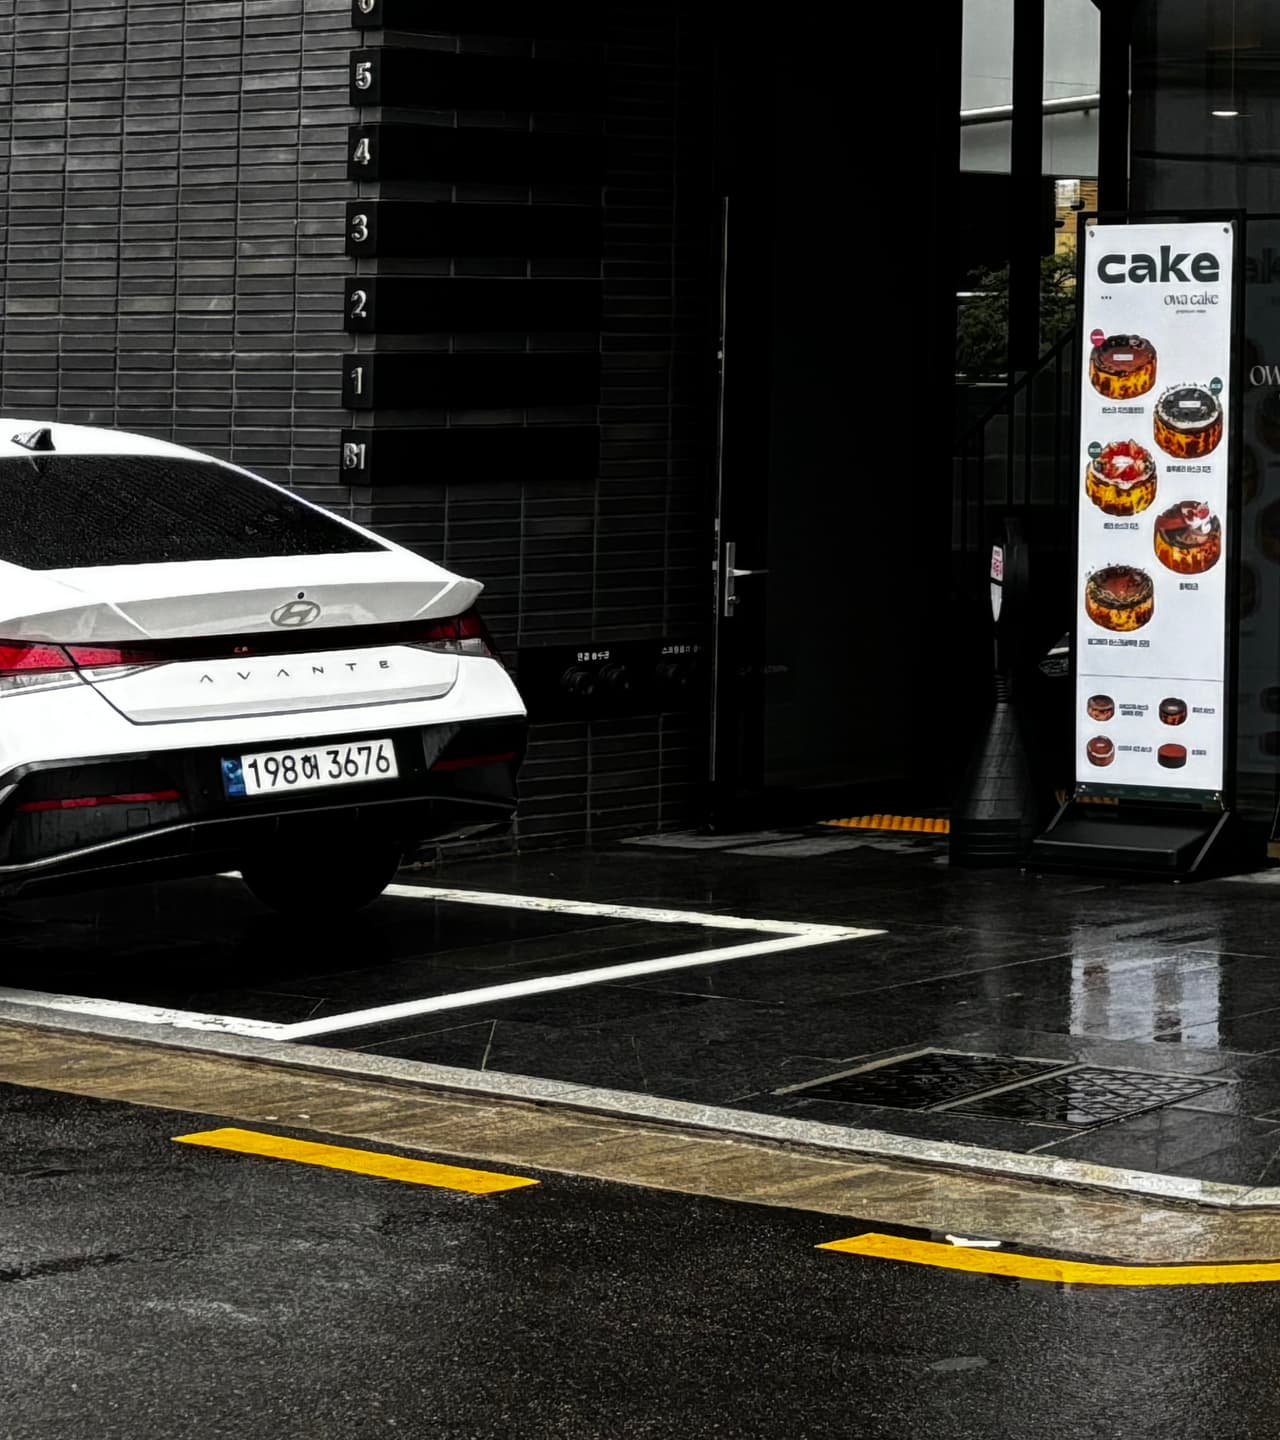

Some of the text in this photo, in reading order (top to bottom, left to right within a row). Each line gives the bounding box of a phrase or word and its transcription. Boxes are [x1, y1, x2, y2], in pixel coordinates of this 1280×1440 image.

[355, 62, 372, 89] 5
[353, 137, 371, 165] 4
[351, 214, 368, 242] 3
[1097, 245, 1220, 284] cake
[351, 290, 367, 318] 2
[1190, 290, 1219, 306] cake
[351, 367, 364, 395] 1
[344, 443, 366, 470] B1
[200, 659, 390, 684] AVANTE
[247, 743, 391, 790] 198허 3676
